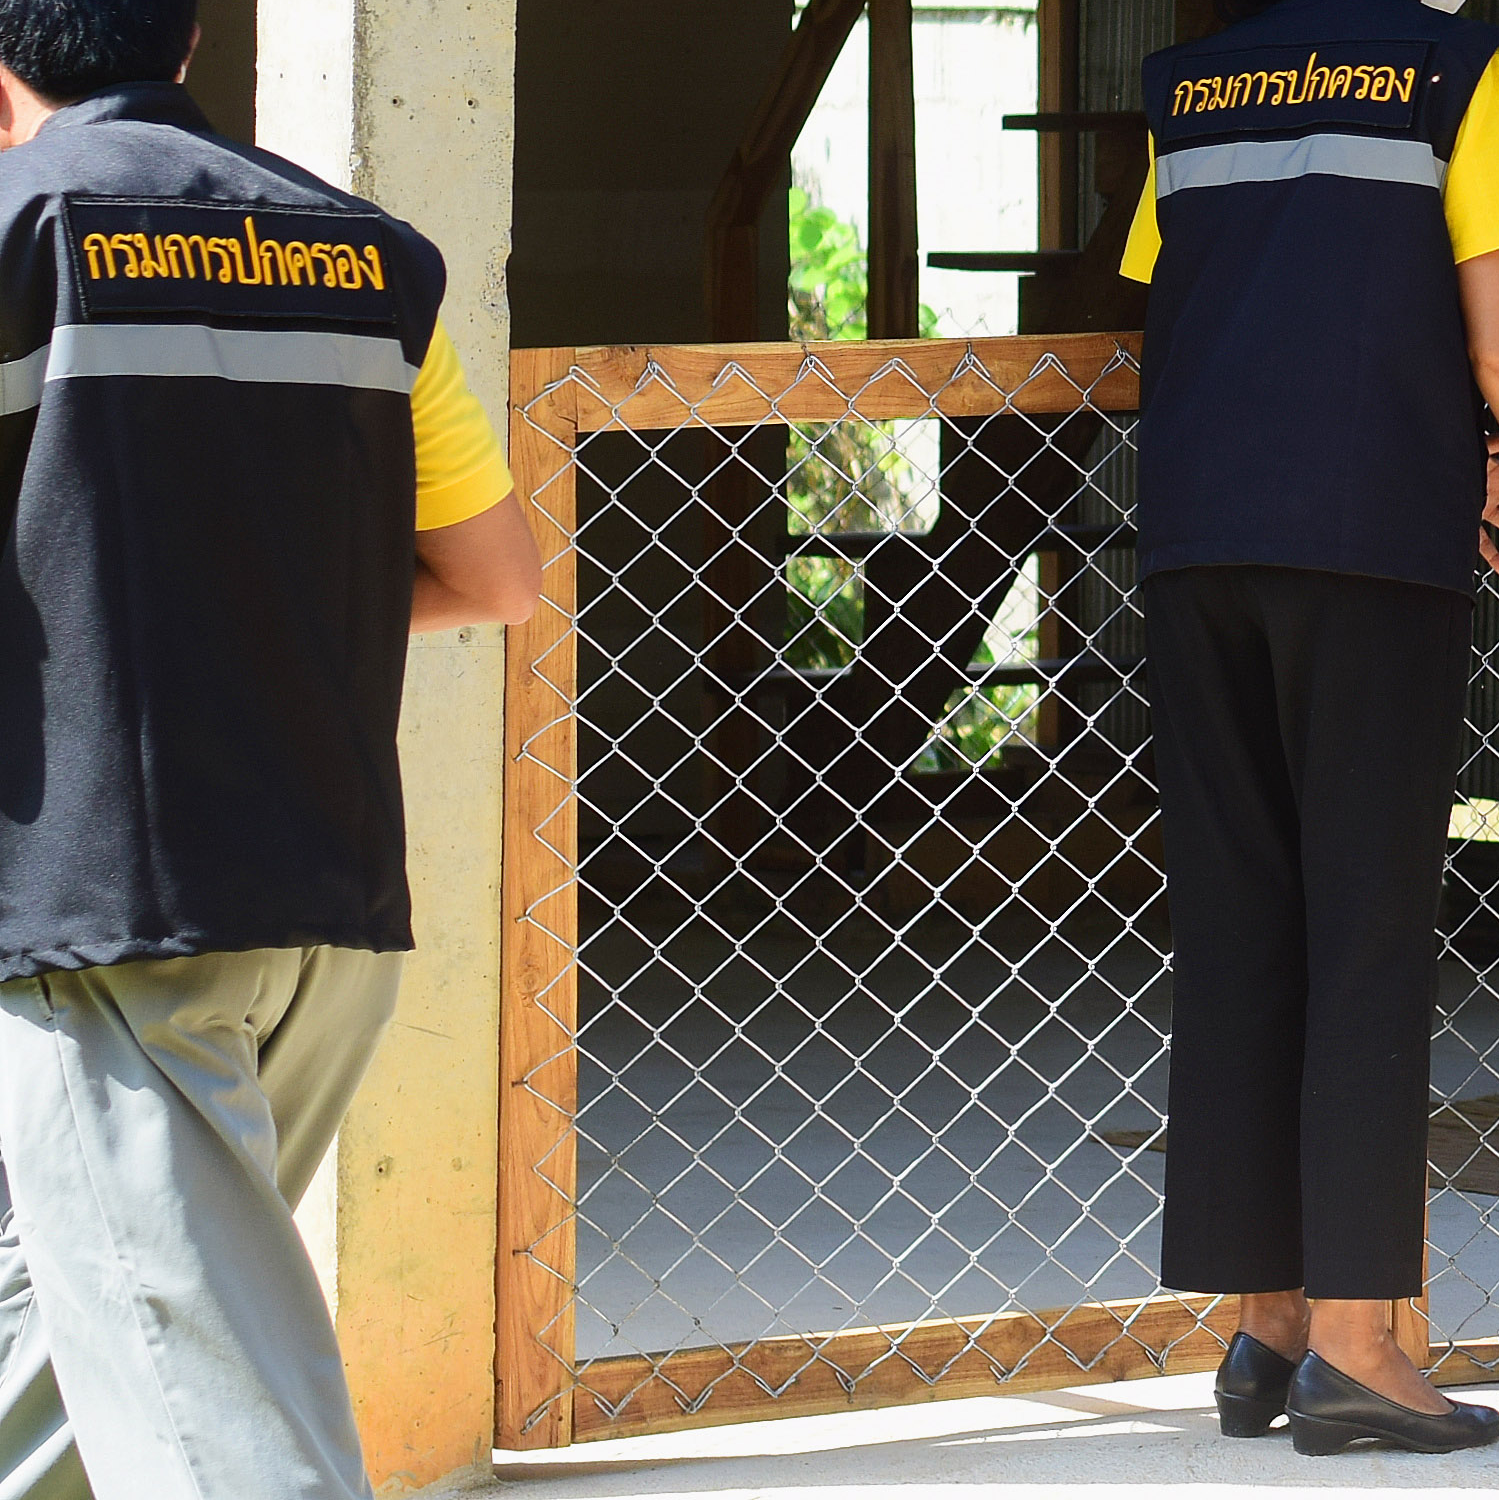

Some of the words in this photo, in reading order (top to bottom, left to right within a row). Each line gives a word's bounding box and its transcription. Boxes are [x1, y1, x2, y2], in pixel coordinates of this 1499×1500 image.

[1171, 52, 1415, 117] กรมการปกครอง
[83, 216, 385, 290] กรมการปกครอง
